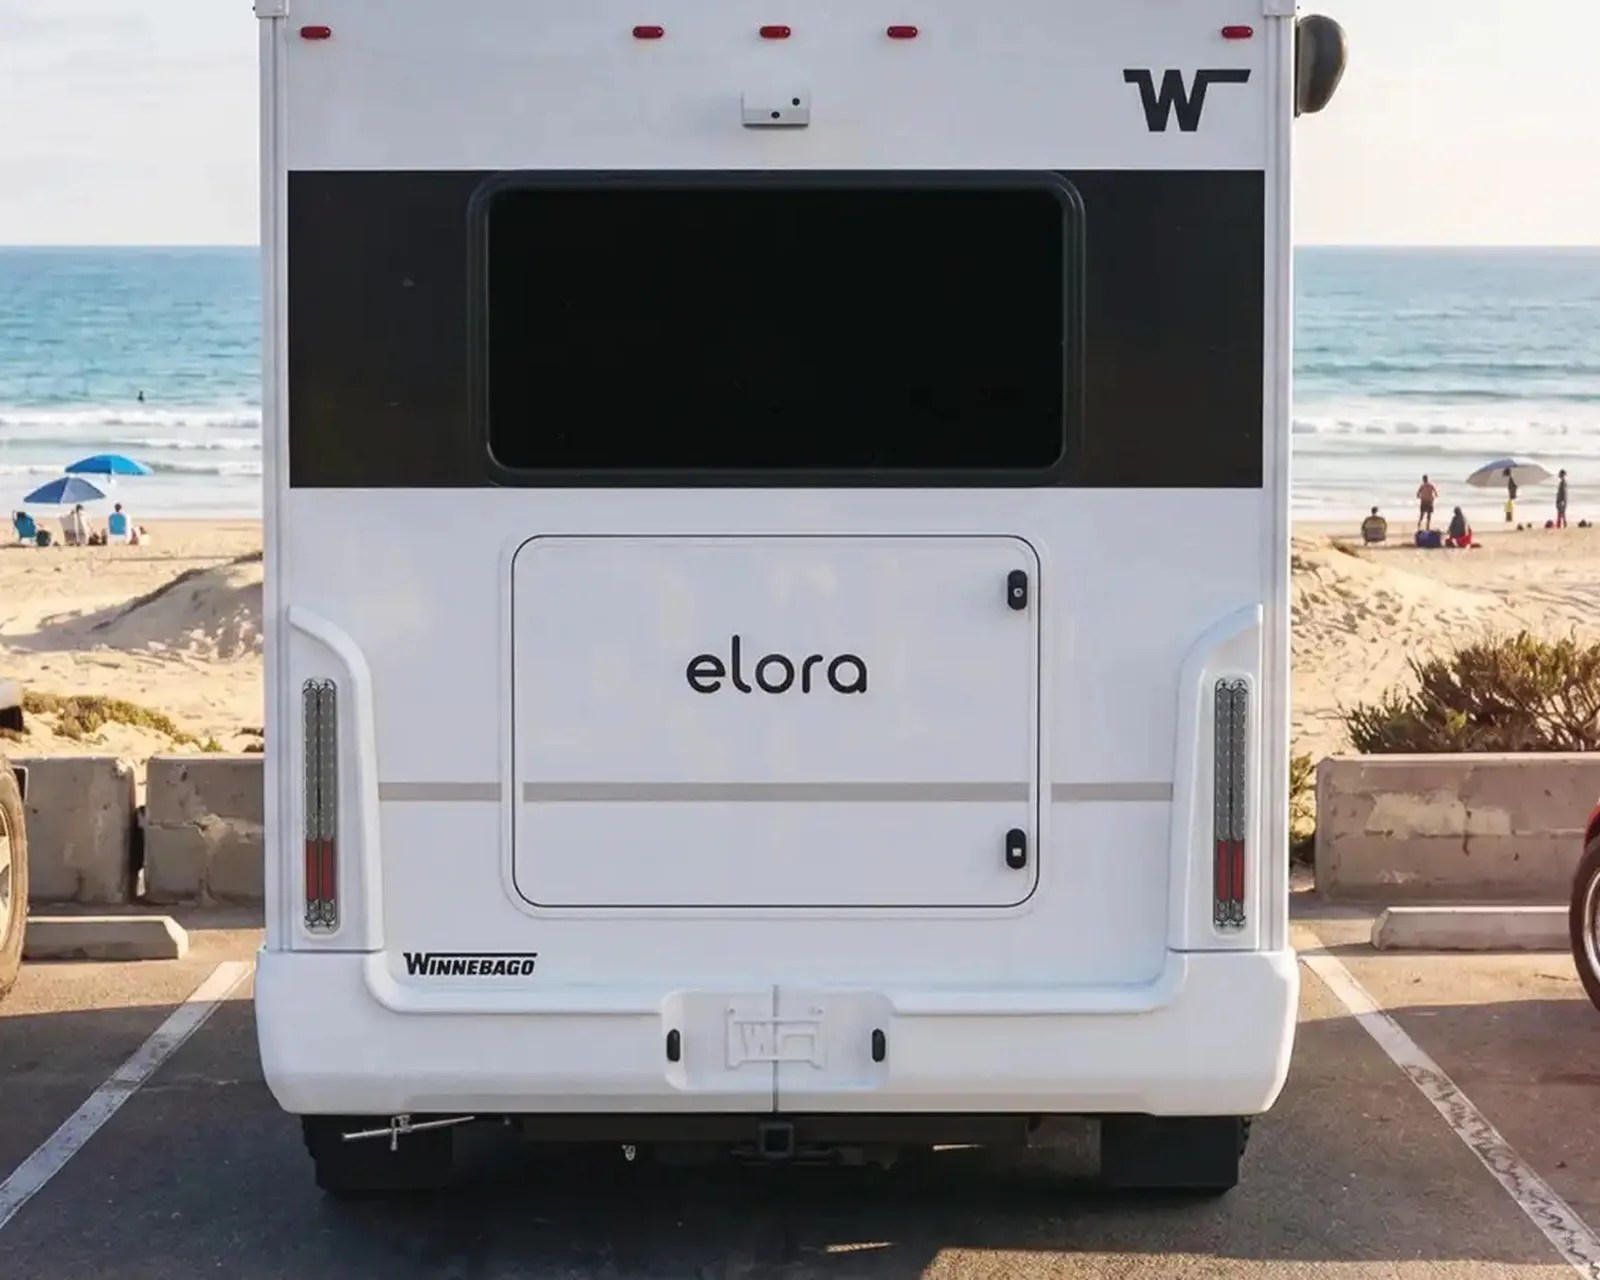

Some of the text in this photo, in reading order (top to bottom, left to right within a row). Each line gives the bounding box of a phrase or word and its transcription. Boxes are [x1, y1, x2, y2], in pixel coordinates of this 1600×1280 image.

[1123, 69, 1251, 132] W
[686, 635, 868, 695] elora
[403, 952, 538, 976] WINNEBAGO
